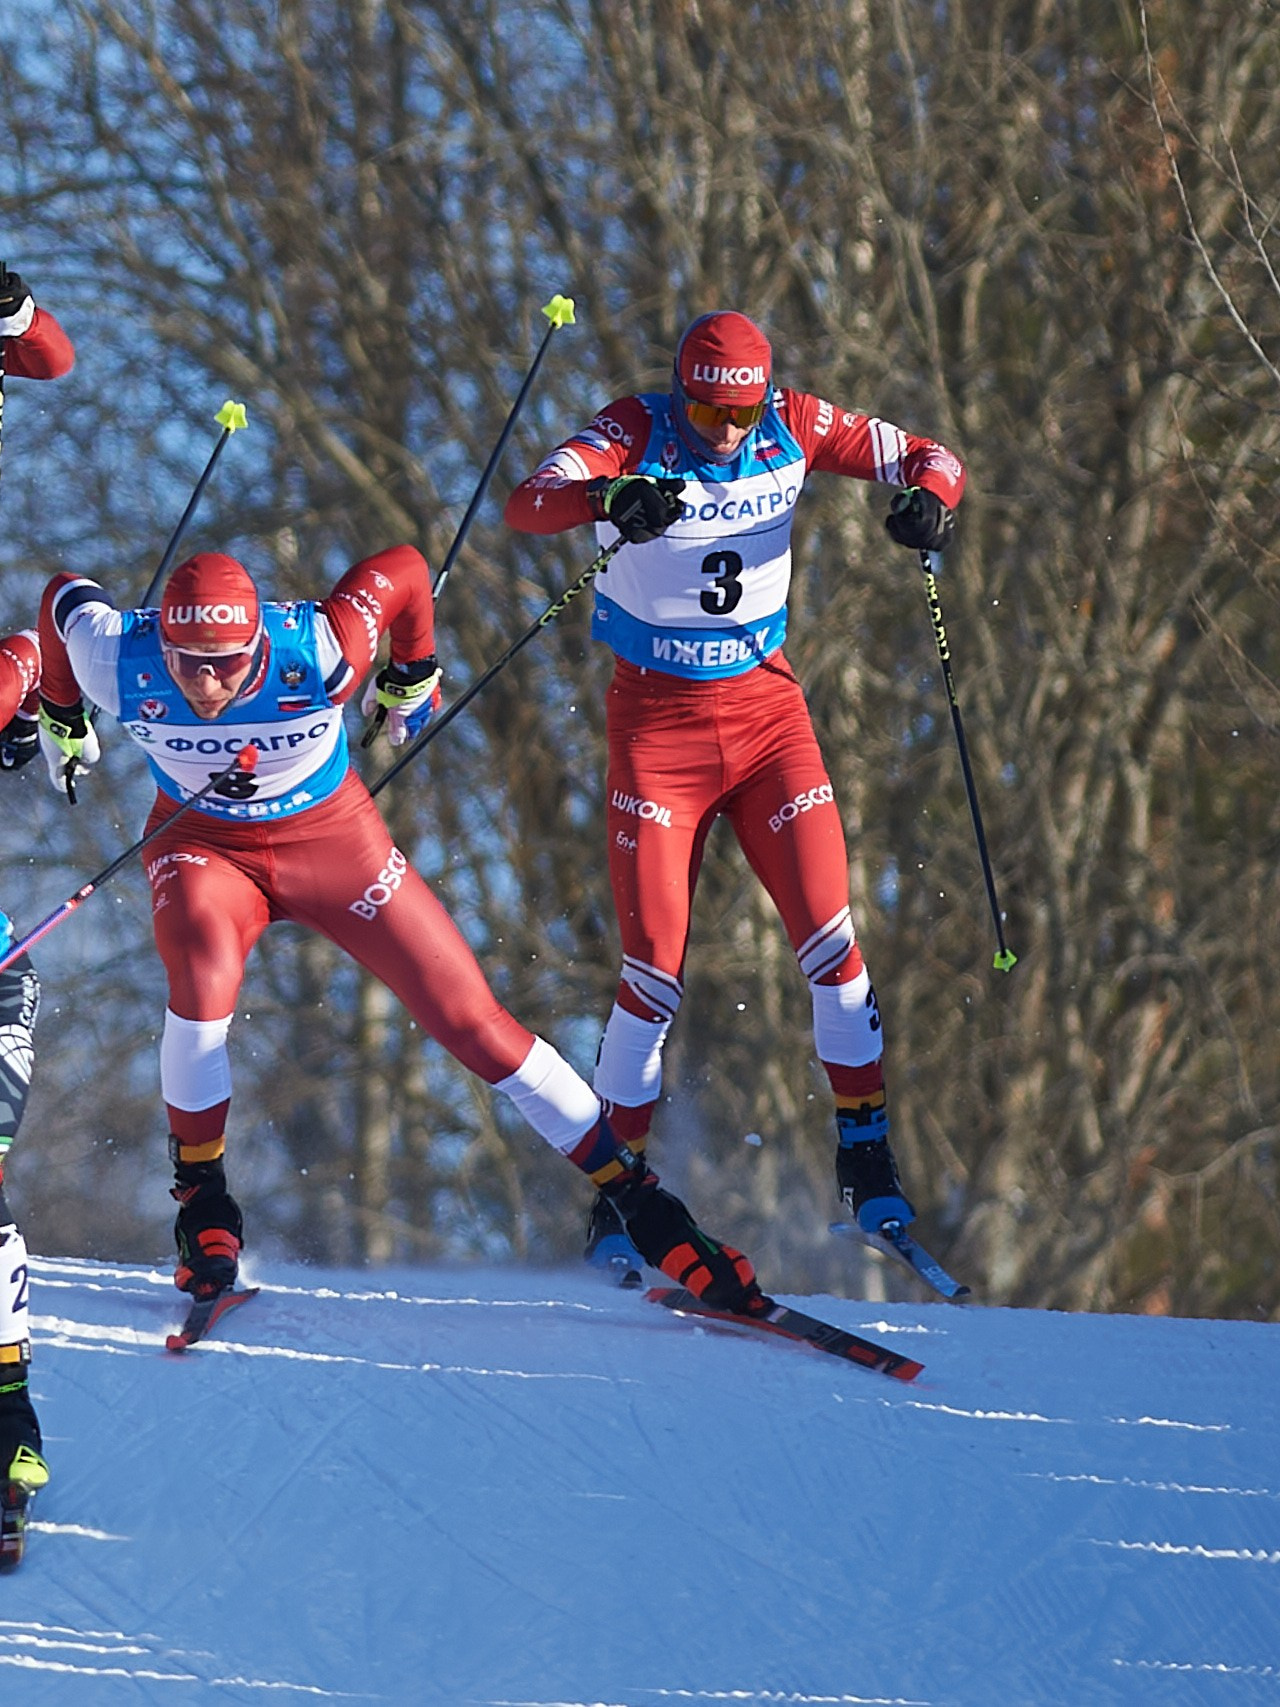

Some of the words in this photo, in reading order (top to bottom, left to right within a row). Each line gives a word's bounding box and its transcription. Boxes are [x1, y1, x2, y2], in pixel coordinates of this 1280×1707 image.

[693, 363, 766, 386] LUKOIL
[699, 550, 744, 616] 3
[167, 603, 249, 625] LUKOIL
[652, 627, 770, 667] ИЖЕВСК
[166, 722, 329, 755] ФОСАГРО
[612, 789, 672, 828] LUKOIL
[768, 783, 834, 833] BOSCO
[349, 846, 407, 921] BOSCO
[10, 1263, 28, 1313] 2
